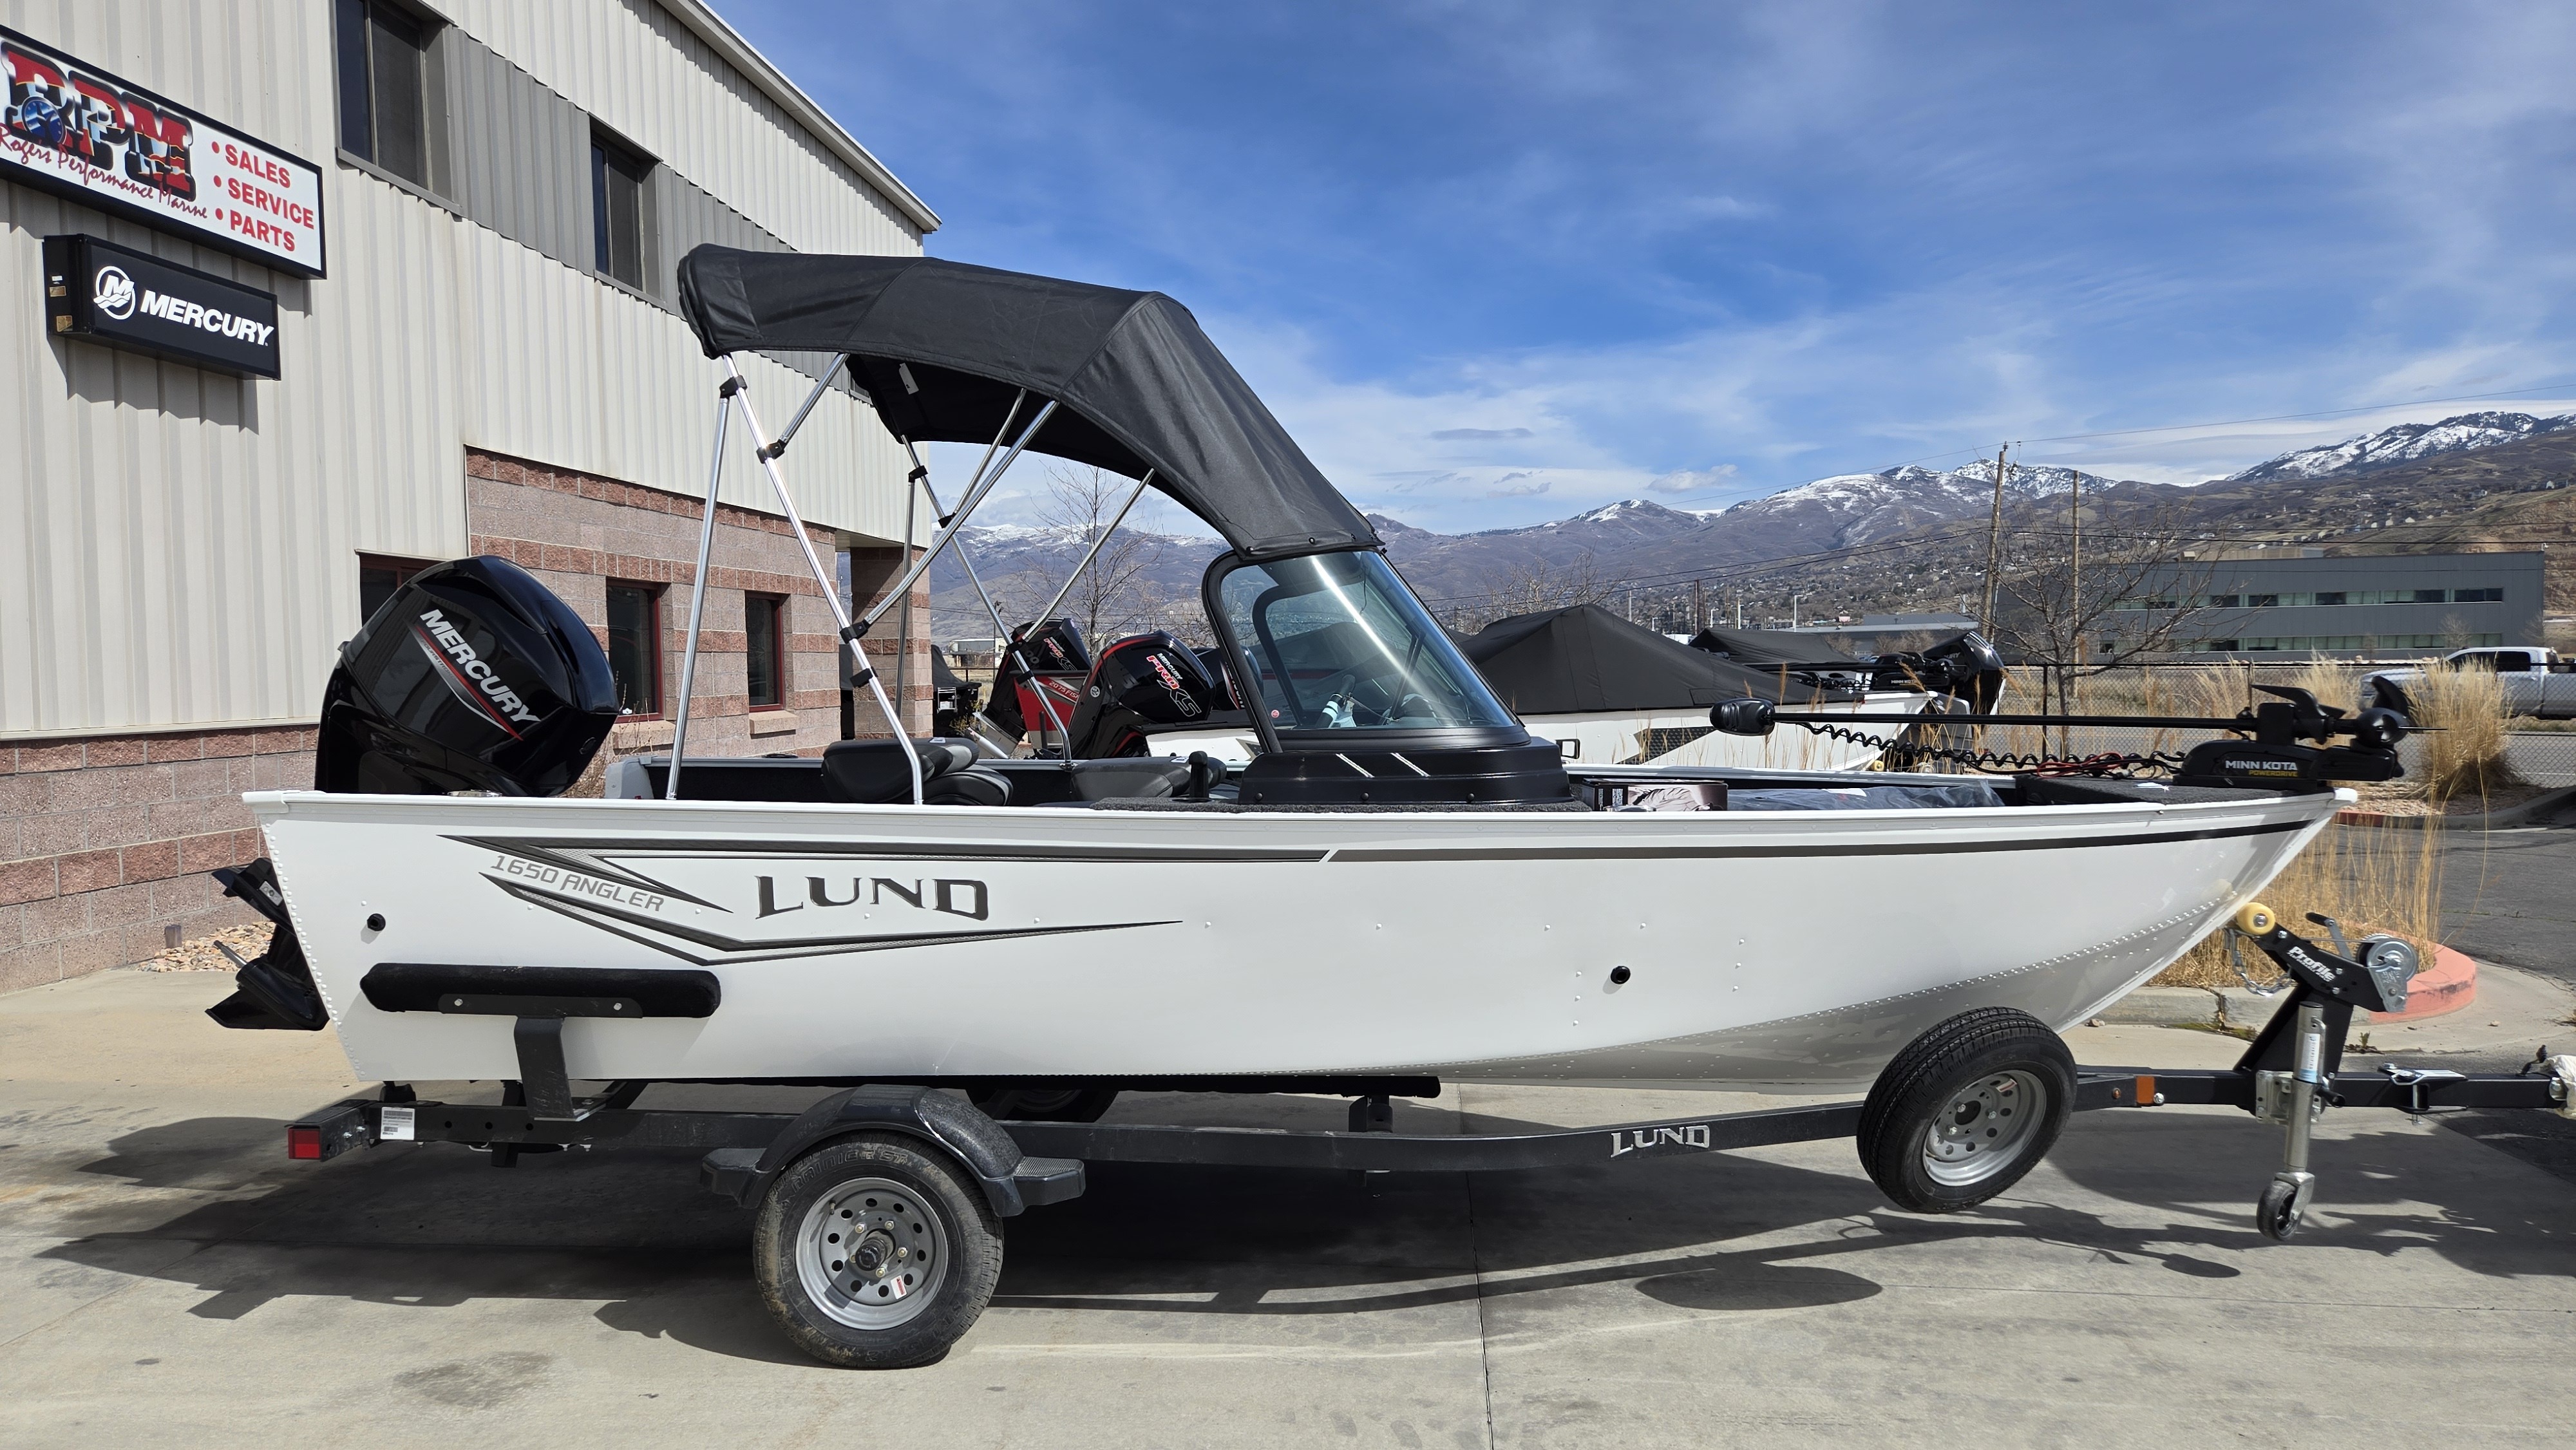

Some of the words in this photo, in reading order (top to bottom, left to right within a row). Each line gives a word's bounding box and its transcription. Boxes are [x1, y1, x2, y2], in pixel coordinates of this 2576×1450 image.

[58, 143, 153, 186] Performance
[158, 182, 207, 219] Marine
[225, 144, 290, 189] SALES
[227, 177, 314, 230] SERVICE
[230, 209, 296, 252] PARTS
[140, 290, 274, 346] MERCURY
[419, 609, 541, 723] MERCURY
[1049, 681, 1067, 693] 2075
[1146, 655, 1179, 690] PRO
[1157, 653, 1183, 680] MERCURY
[1157, 679, 1202, 717] XS
[2226, 760, 2260, 769] MINN
[2262, 762, 2298, 770] KOTA
[491, 855, 558, 884] 1650
[560, 874, 665, 912] ANGLER
[754, 876, 989, 921] LUND
[2289, 946, 2336, 979] Profile
[1610, 1125, 1710, 1158] LUND
